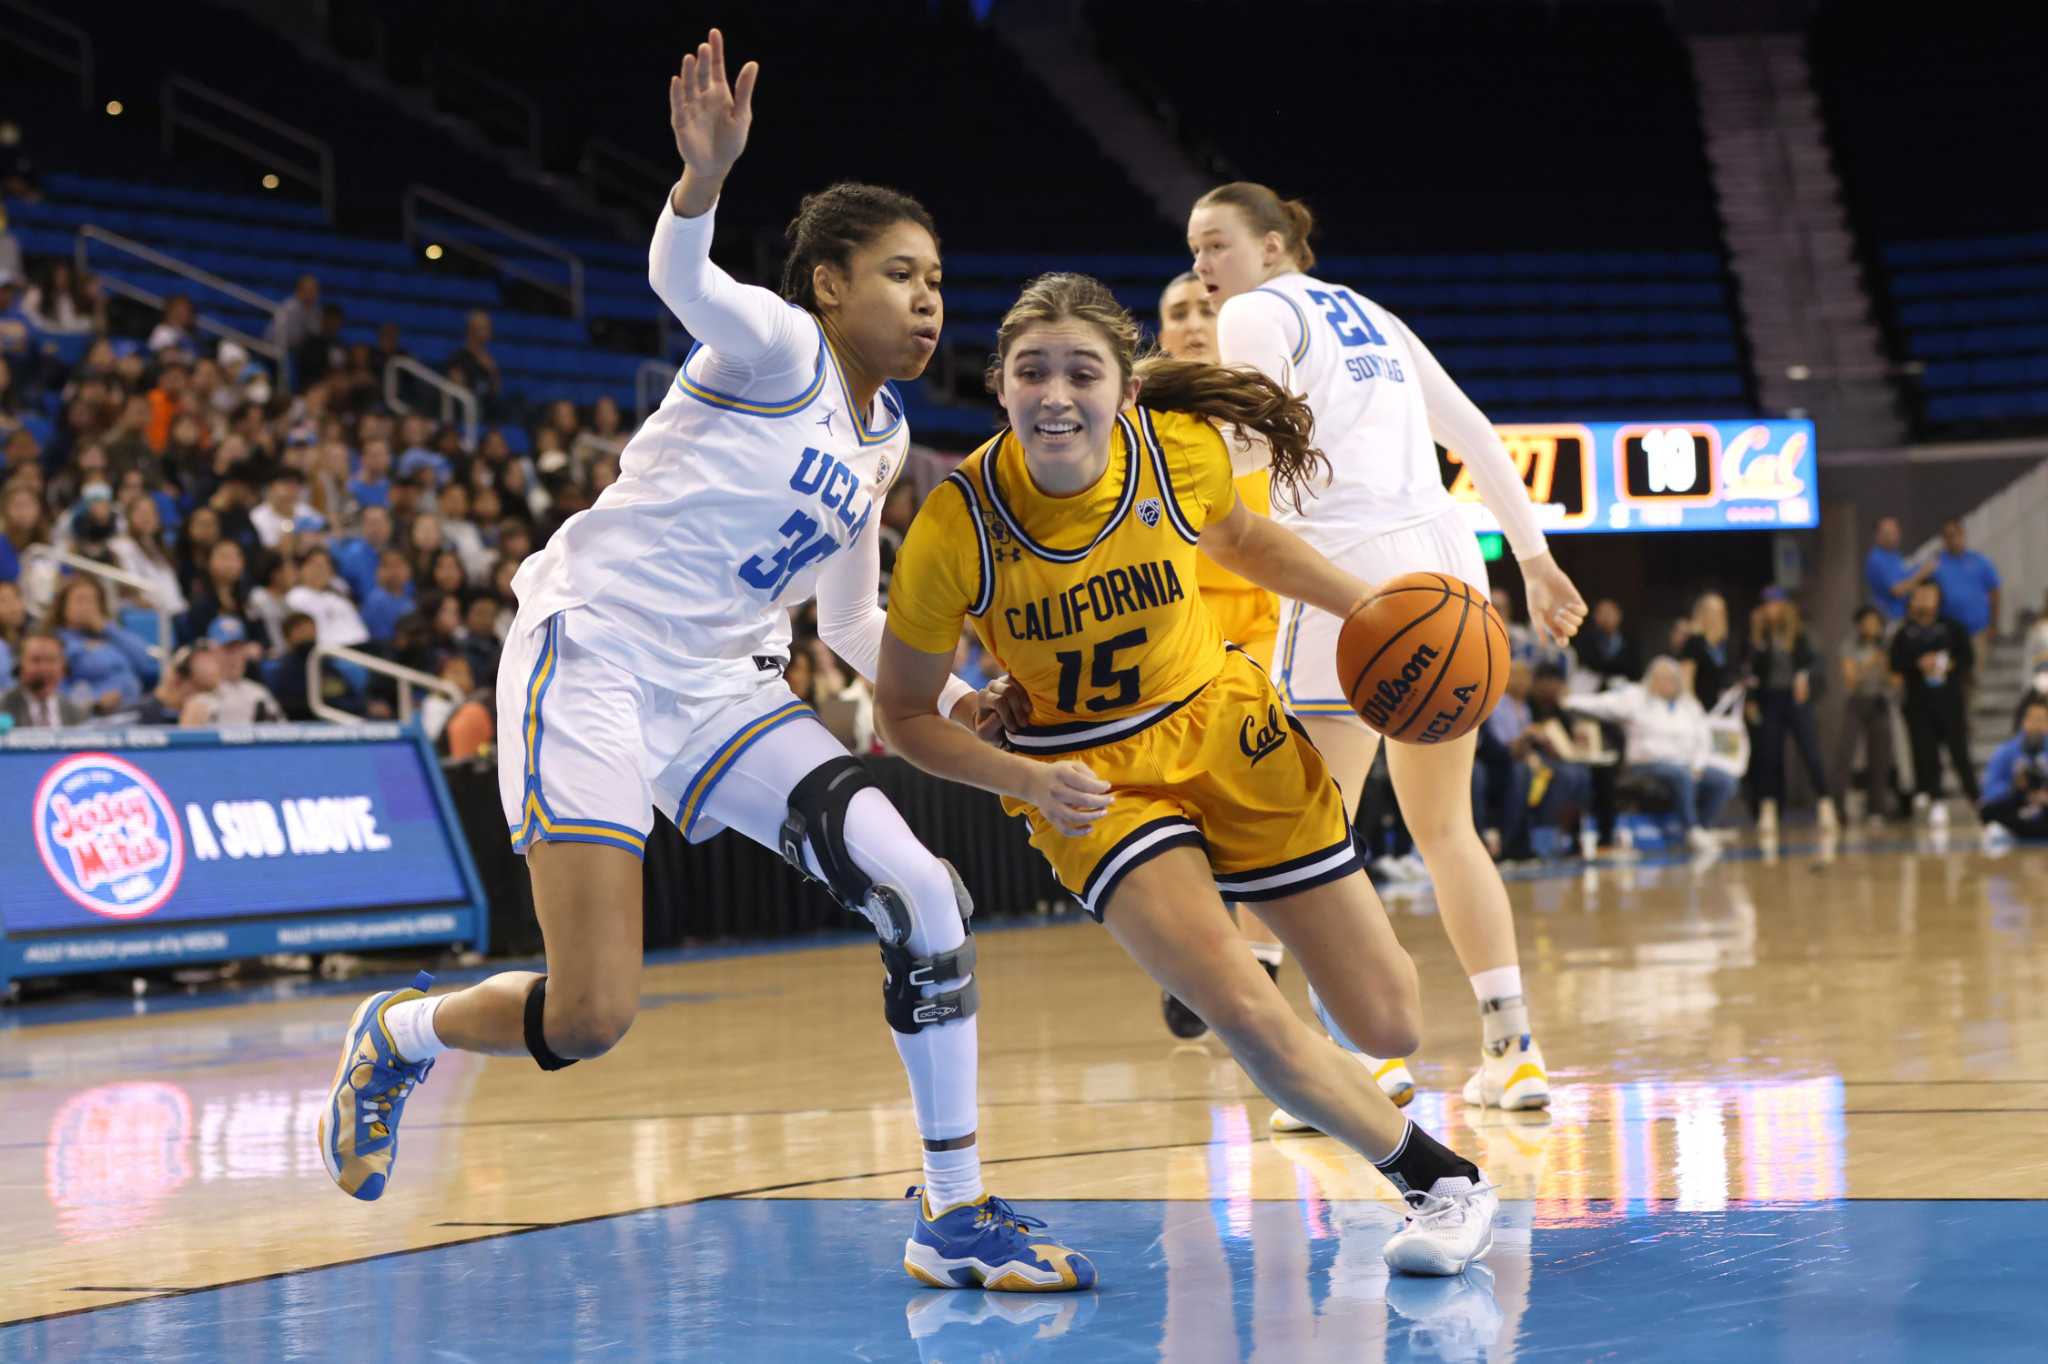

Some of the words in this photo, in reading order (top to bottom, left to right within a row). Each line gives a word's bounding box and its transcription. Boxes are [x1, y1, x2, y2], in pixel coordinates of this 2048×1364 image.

[1305, 289, 1387, 347] 21
[789, 447, 873, 551] UCLA
[1721, 426, 1809, 500] Cal
[1005, 559, 1185, 642] CALIFORNIA
[1055, 628, 1147, 713] 15
[1360, 643, 1439, 727] Wilson
[1239, 704, 1287, 768] Cal
[1417, 681, 1480, 744] UCLA
